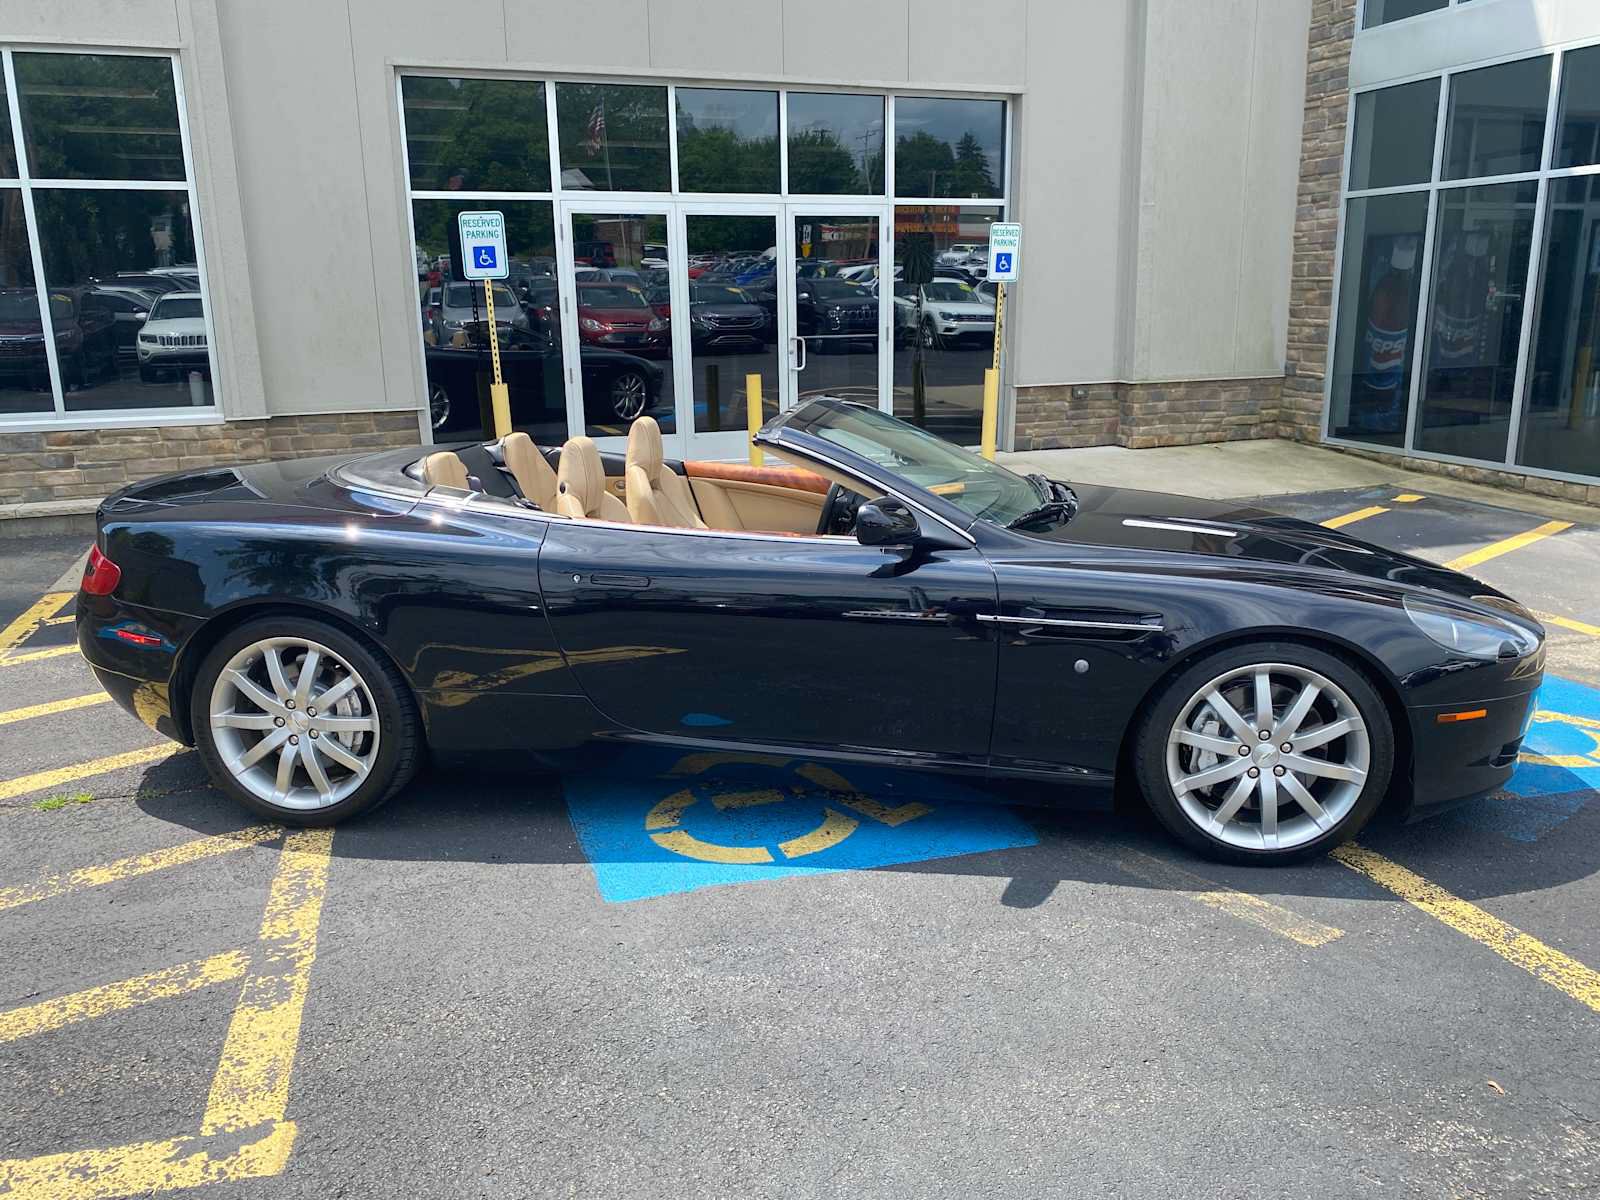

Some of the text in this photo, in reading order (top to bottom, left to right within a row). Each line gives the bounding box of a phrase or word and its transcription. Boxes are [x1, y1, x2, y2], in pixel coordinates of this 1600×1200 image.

[462, 218, 500, 228] RESERVED
[466, 230, 499, 239] PARKING
[992, 228, 1018, 237] RESERVED
[993, 238, 1017, 247] PARKING
